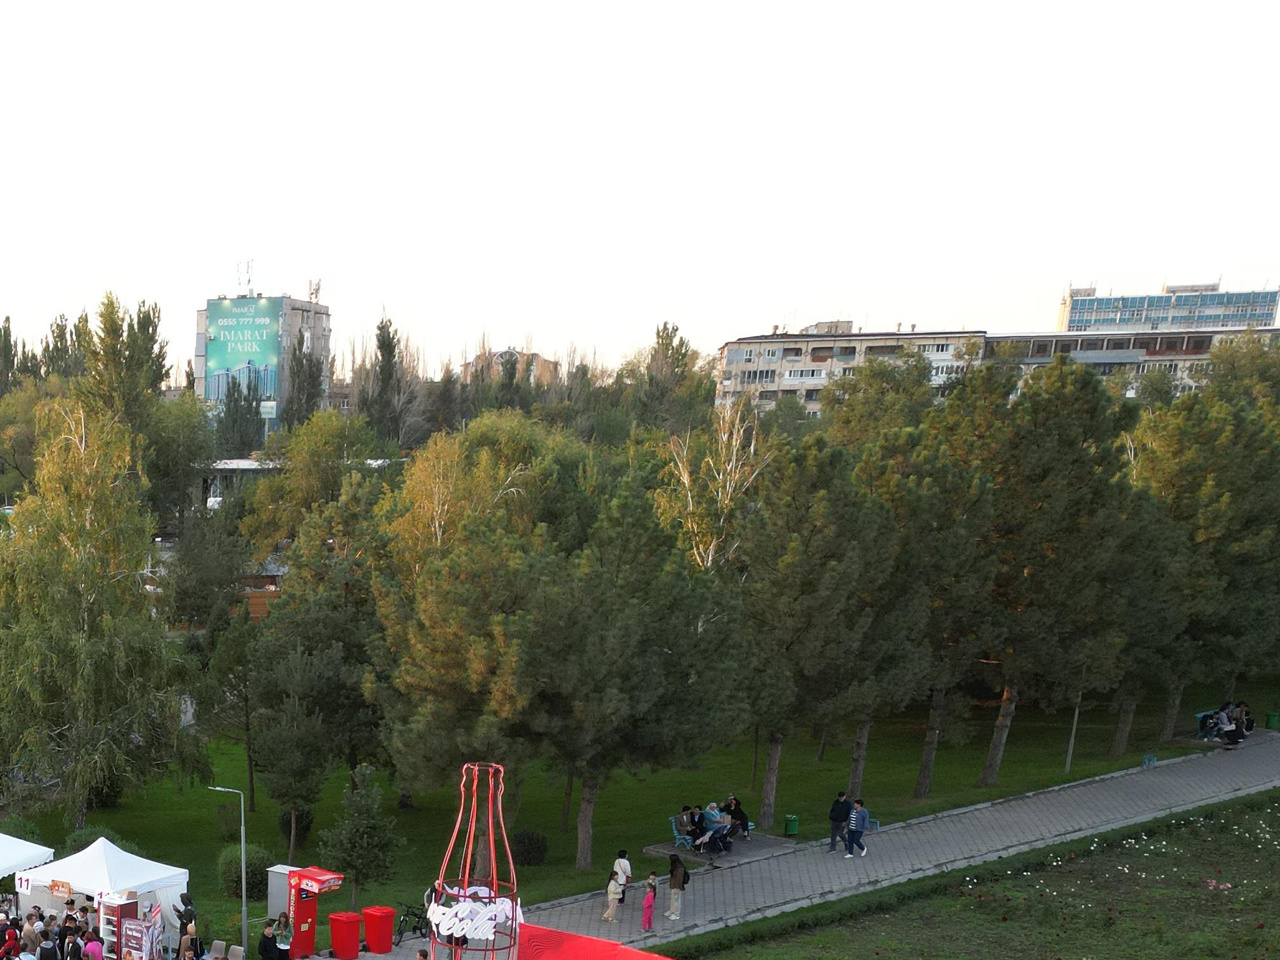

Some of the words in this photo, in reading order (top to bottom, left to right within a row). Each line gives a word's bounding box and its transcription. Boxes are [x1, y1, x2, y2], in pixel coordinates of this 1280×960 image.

[217, 318, 237, 326] 0555
[254, 317, 270, 325] 999
[220, 330, 269, 341] IMARAT
[227, 341, 260, 352] PARK
[18, 876, 30, 890] 11
